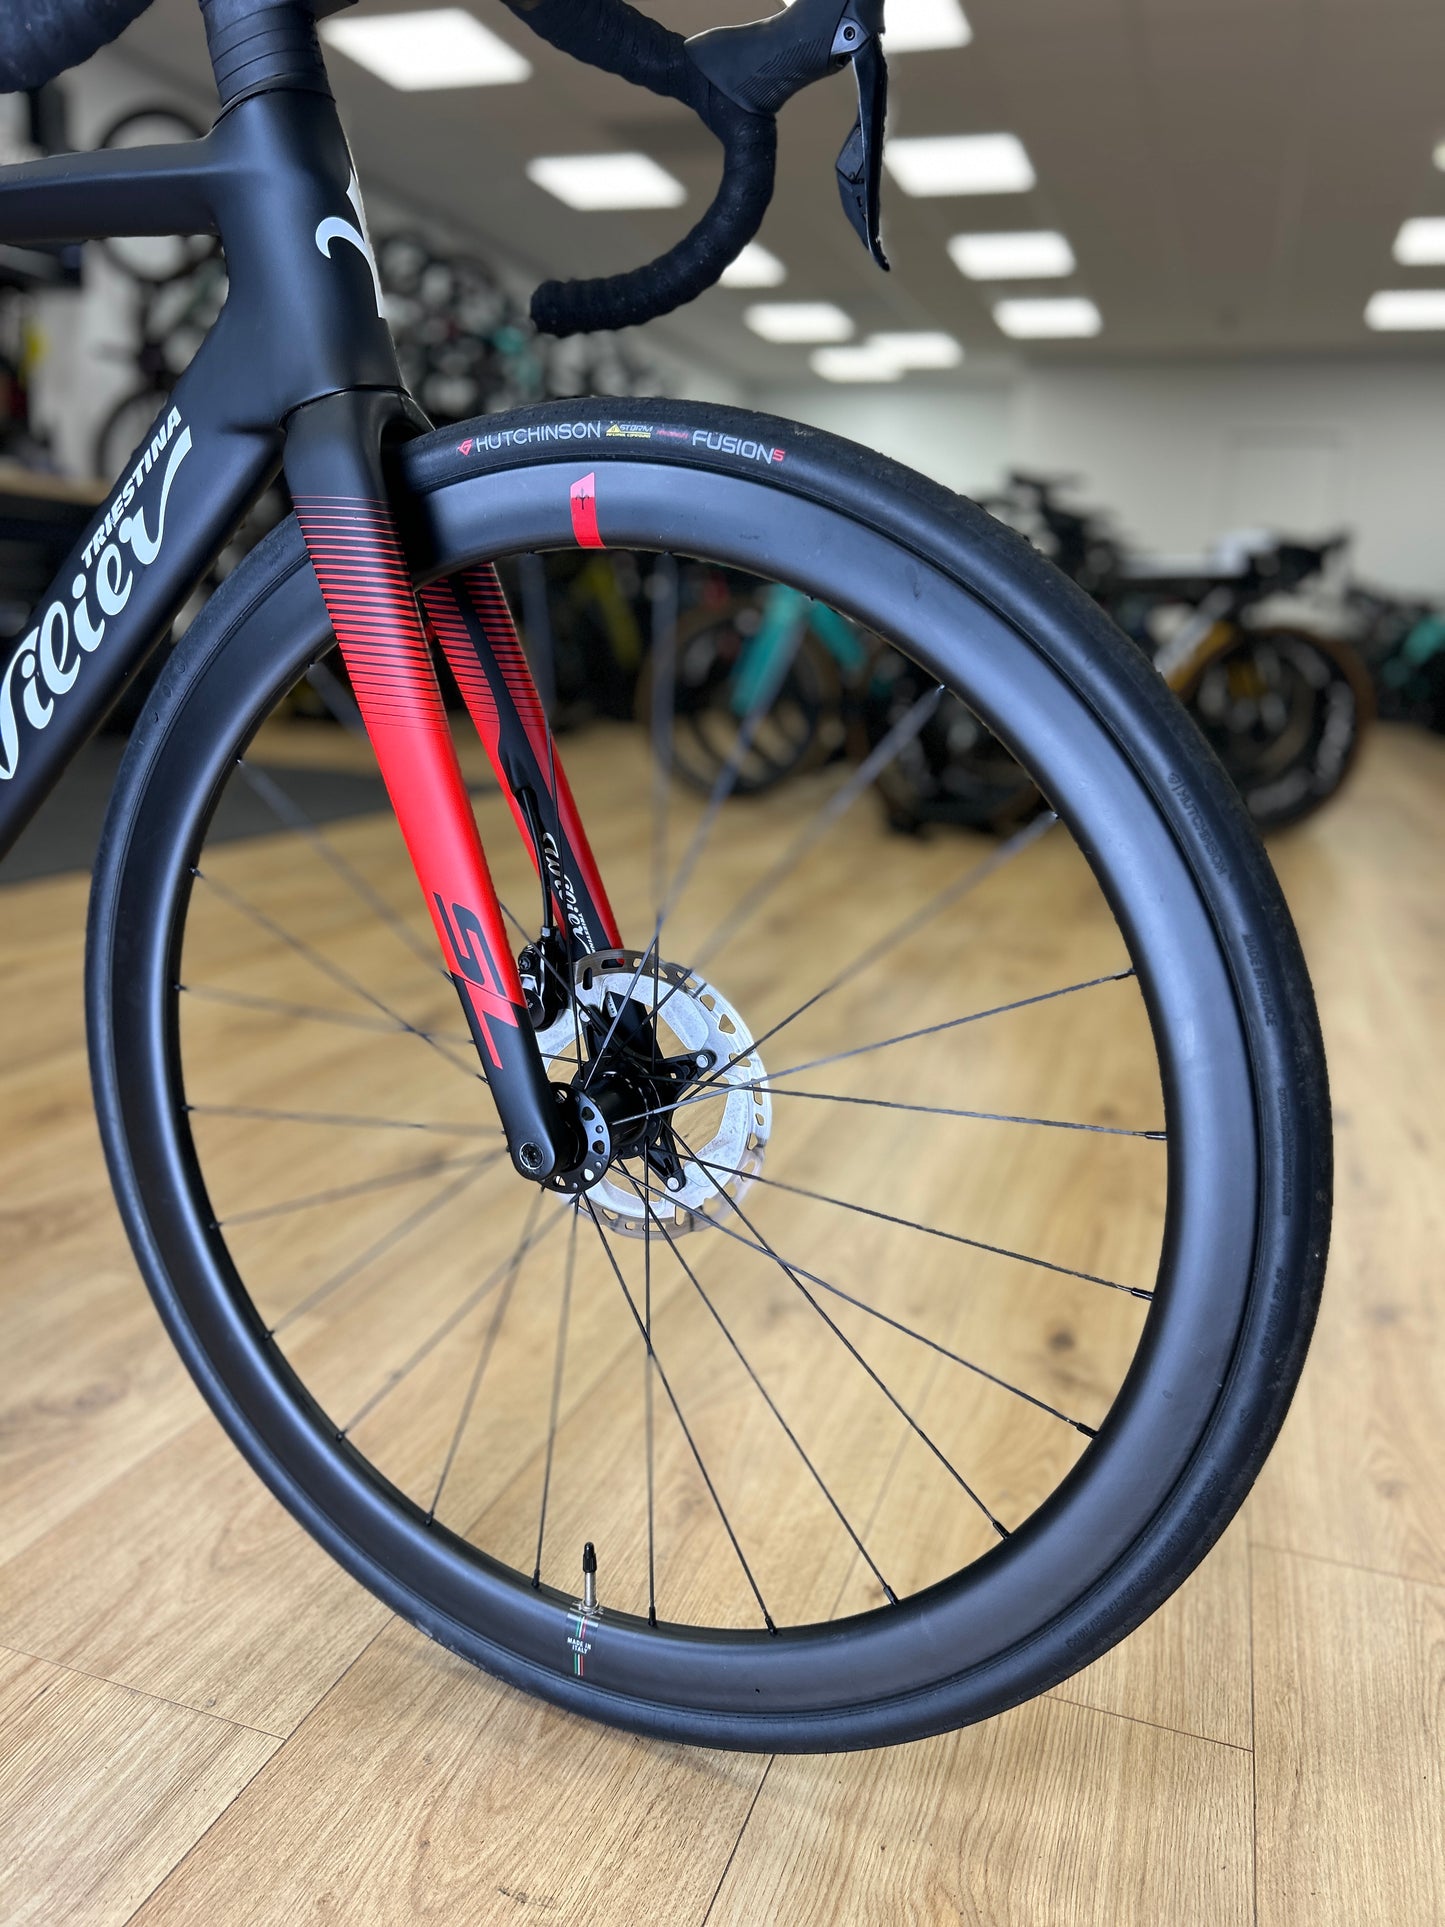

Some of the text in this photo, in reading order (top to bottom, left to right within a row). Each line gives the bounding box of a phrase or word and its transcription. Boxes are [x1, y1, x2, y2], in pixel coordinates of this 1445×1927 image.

[476, 420, 601, 452] HUTCHINSON
[80, 406, 181, 568] TRIESTINA
[432, 891, 519, 1070] SL
[567, 1637, 592, 1650] MADE IN
[572, 1644, 588, 1655] ITALY
